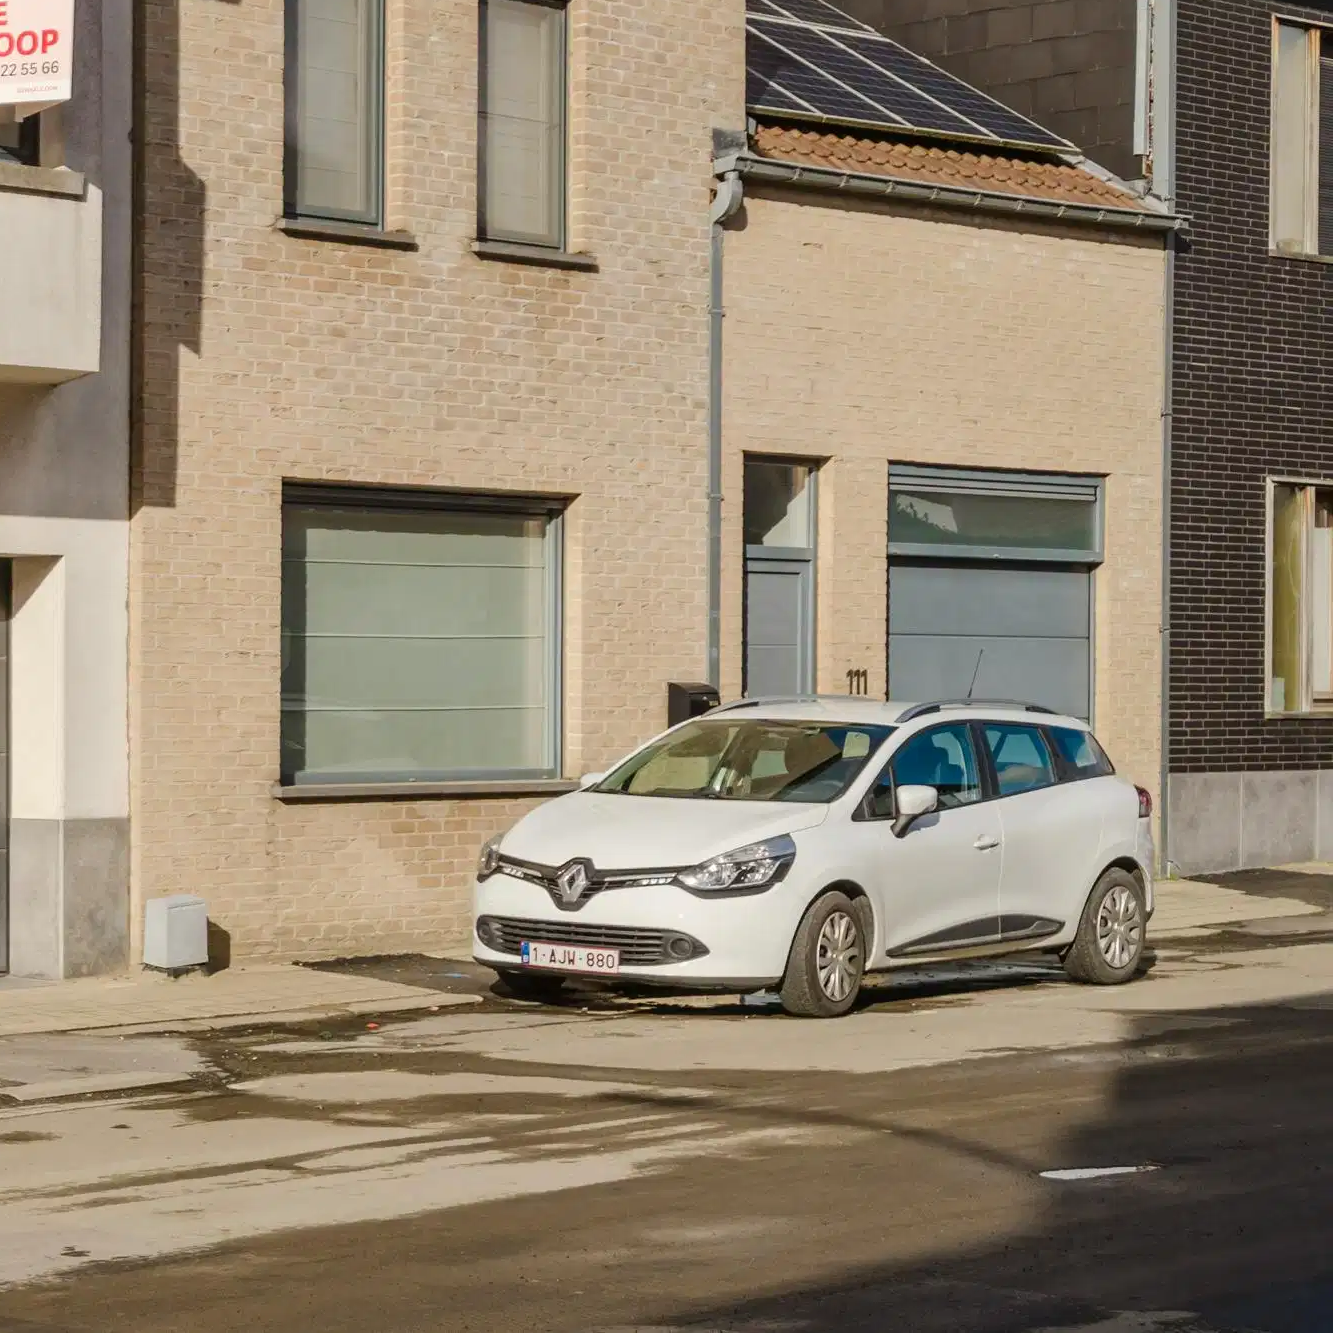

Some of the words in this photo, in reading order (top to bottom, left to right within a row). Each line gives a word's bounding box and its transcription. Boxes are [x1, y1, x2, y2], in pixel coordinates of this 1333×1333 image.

[0, 63, 17, 77] 22
[20, 62, 38, 76] 55
[41, 60, 59, 75] 66
[846, 669, 868, 695] 111
